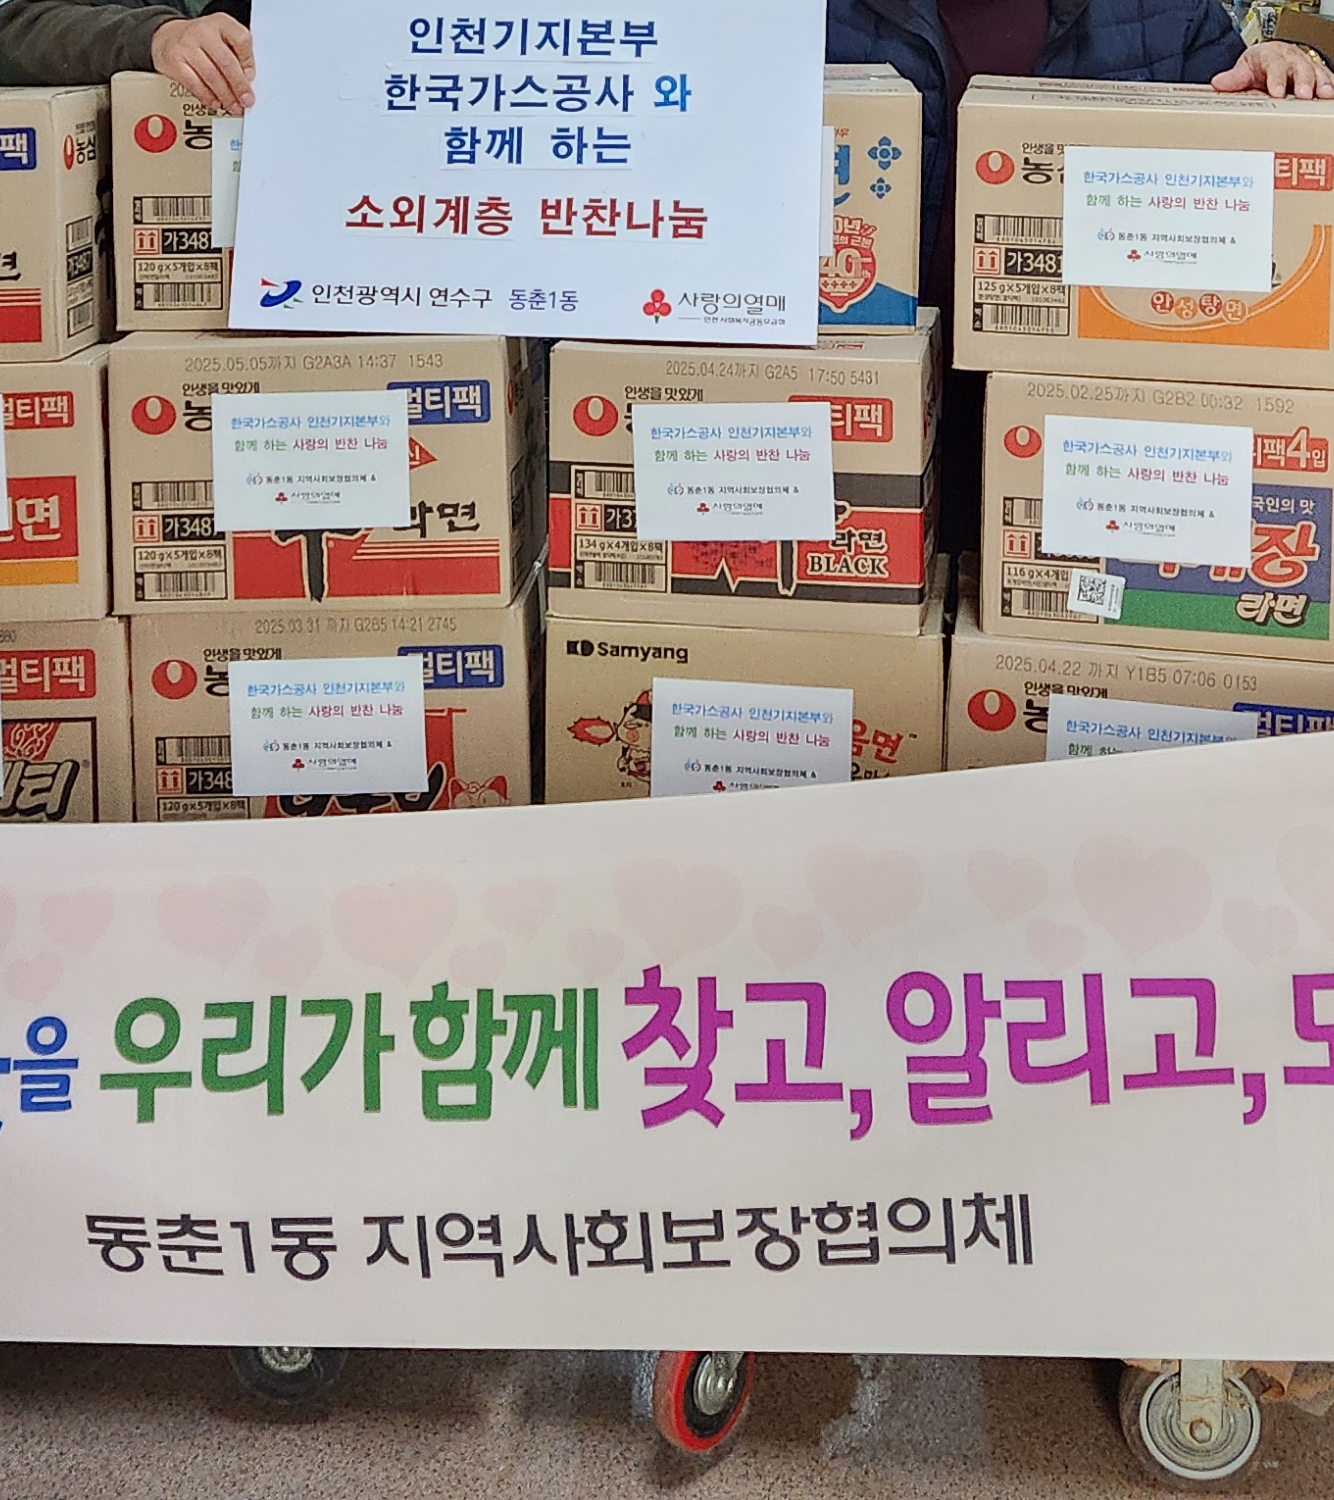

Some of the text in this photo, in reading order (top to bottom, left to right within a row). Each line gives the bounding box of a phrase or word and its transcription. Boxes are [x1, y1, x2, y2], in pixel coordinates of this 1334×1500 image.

[408, 17, 658, 57] 인천기지본부
[384, 72, 693, 113] 한국가스공사 와
[443, 126, 632, 165] 함께 하는
[345, 194, 709, 240] 소외계층 반찬나눔
[311, 281, 579, 315] 인천광역시 연수구 동춘1동
[678, 291, 787, 316] 사랑의열매
[358, 354, 396, 369] 14:37
[409, 353, 443, 368] 1543
[807, 555, 886, 576] BLACK
[1236, 592, 1309, 626] 라면
[599, 641, 688, 663] Samyang
[99, 994, 394, 1125] 우리가
[410, 981, 600, 1122] 함께
[622, 964, 874, 1141] 찾고,
[886, 970, 1267, 1127] 알리고,
[86, 1193, 1034, 1281] 동춘1동 지역사회보장협의체
